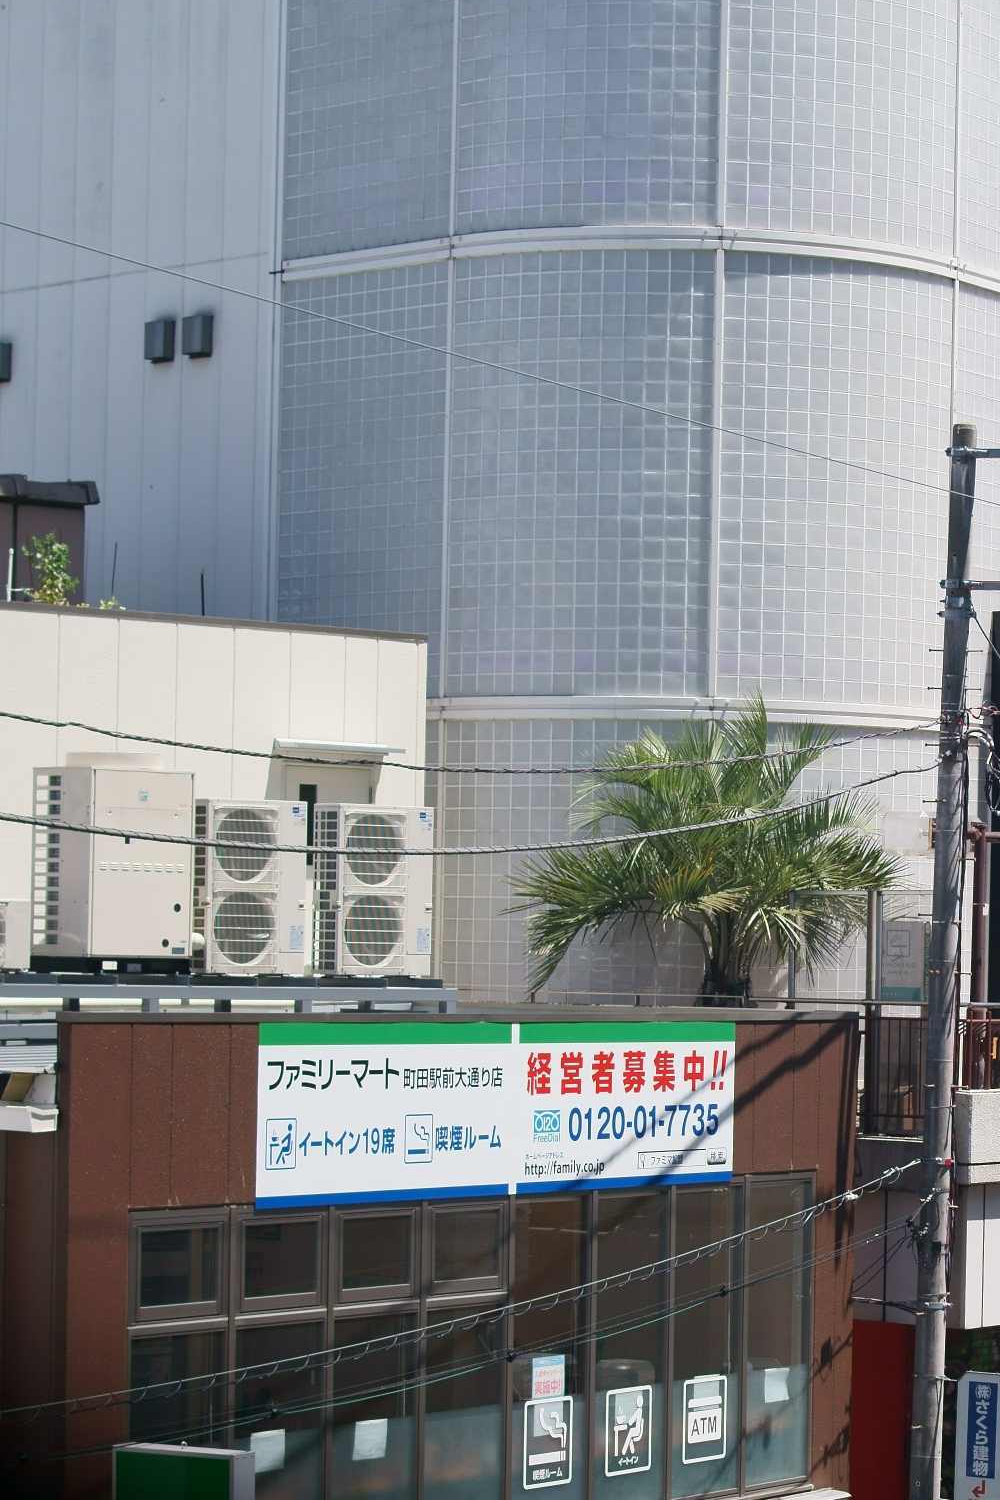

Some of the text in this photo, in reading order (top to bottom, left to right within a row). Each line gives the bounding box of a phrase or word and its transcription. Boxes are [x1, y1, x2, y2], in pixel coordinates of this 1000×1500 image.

[267, 1057, 504, 1091] ファミリーマート 町田駅前大通り店
[568, 1103, 719, 1142] 0120-01-7735
[299, 1127, 396, 1157] イートイン19席
[435, 1125, 502, 1151] 喫煙ルーム
[524, 1158, 605, 1177] http://family.co.jp
[690, 1416, 718, 1437] ATM
